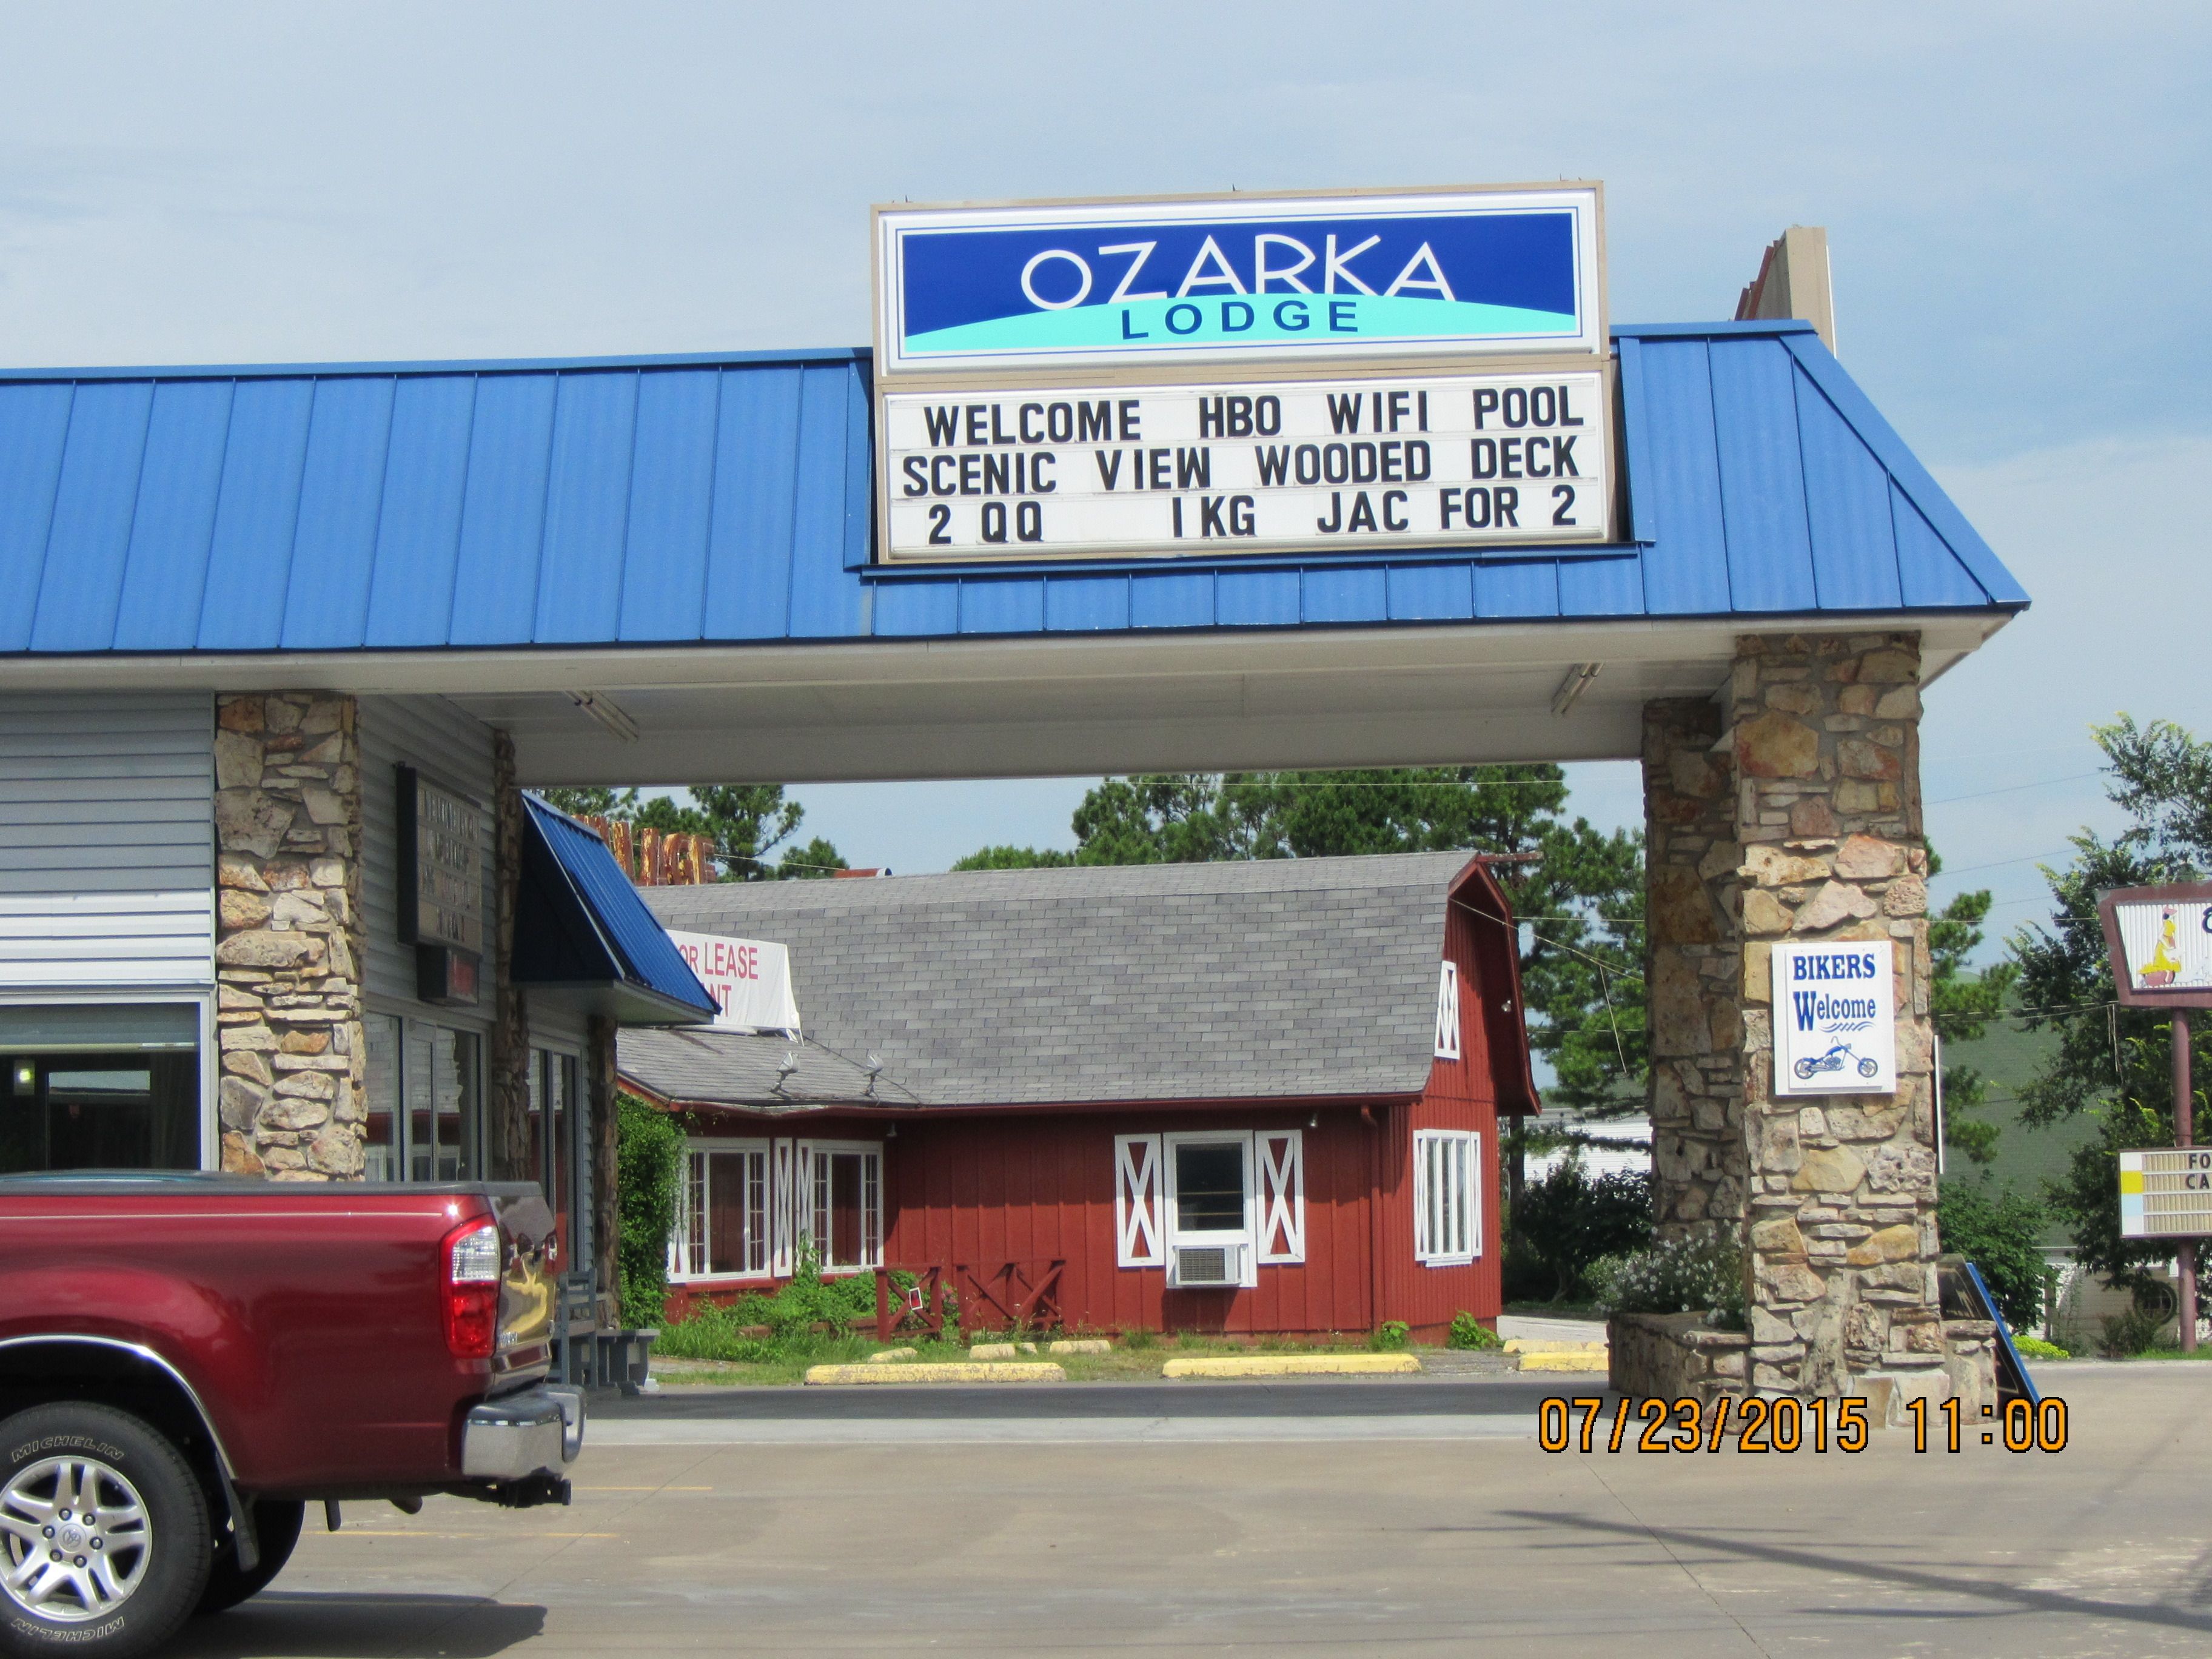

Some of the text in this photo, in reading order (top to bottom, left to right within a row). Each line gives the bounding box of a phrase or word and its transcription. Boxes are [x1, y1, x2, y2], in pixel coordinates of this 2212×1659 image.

[1021, 233, 1456, 311] OZARKA
[1121, 300, 1358, 340] LODGE
[923, 386, 1584, 446] WELCOME HBO WIFI POOL
[903, 435, 1579, 497] SCENIC VIEW WOODED DECK
[929, 503, 952, 545] 2
[981, 500, 1042, 543] QQ
[1201, 495, 1255, 537] KG
[1317, 490, 1408, 533] JAC
[1439, 486, 1518, 530] FOR
[1552, 484, 1577, 526] 2
[675, 942, 759, 980] OR LEASE
[1792, 953, 1876, 980] BIKERS
[1792, 990, 1876, 1031] Welcome
[11, 1435, 125, 1463] MICHELIN
[11, 1617, 125, 1642] MICHELIN
